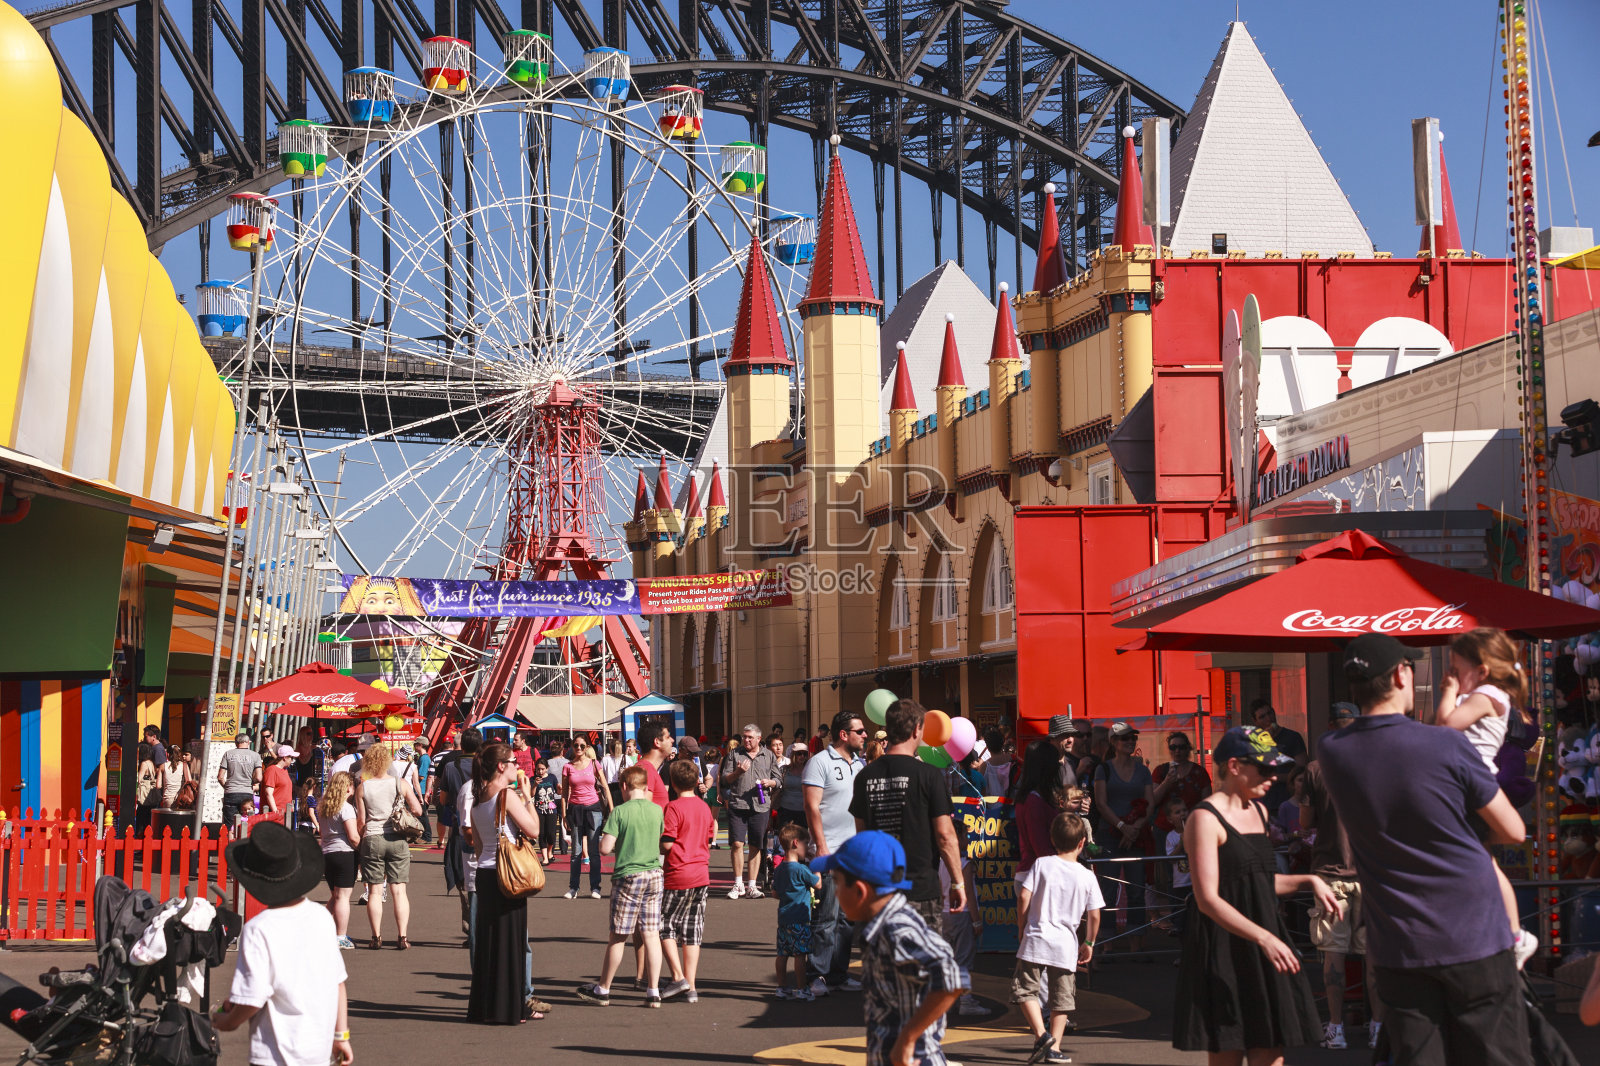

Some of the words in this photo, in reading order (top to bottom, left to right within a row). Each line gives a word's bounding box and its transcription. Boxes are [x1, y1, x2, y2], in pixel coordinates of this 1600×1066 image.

[1307, 433, 1350, 482] PARLOUR
[650, 578, 690, 588] ANNUAL
[692, 576, 714, 586] PASS
[716, 573, 752, 584] SPECIAL
[469, 582, 494, 613] for
[498, 581, 529, 613] fun
[531, 592, 574, 602] since
[577, 591, 613, 606] 1935
[673, 604, 705, 612] UPGRADE
[724, 600, 754, 609] ANNUAL
[708, 594, 729, 603] simply
[1282, 602, 1467, 632] Coca-Cola
[288, 692, 357, 704] Coca-Cola
[834, 766, 844, 781] 3
[963, 813, 1009, 838] BOOK
[966, 839, 1011, 859] YOUR
[976, 881, 1015, 903] ART
[979, 906, 1018, 926] TODA
